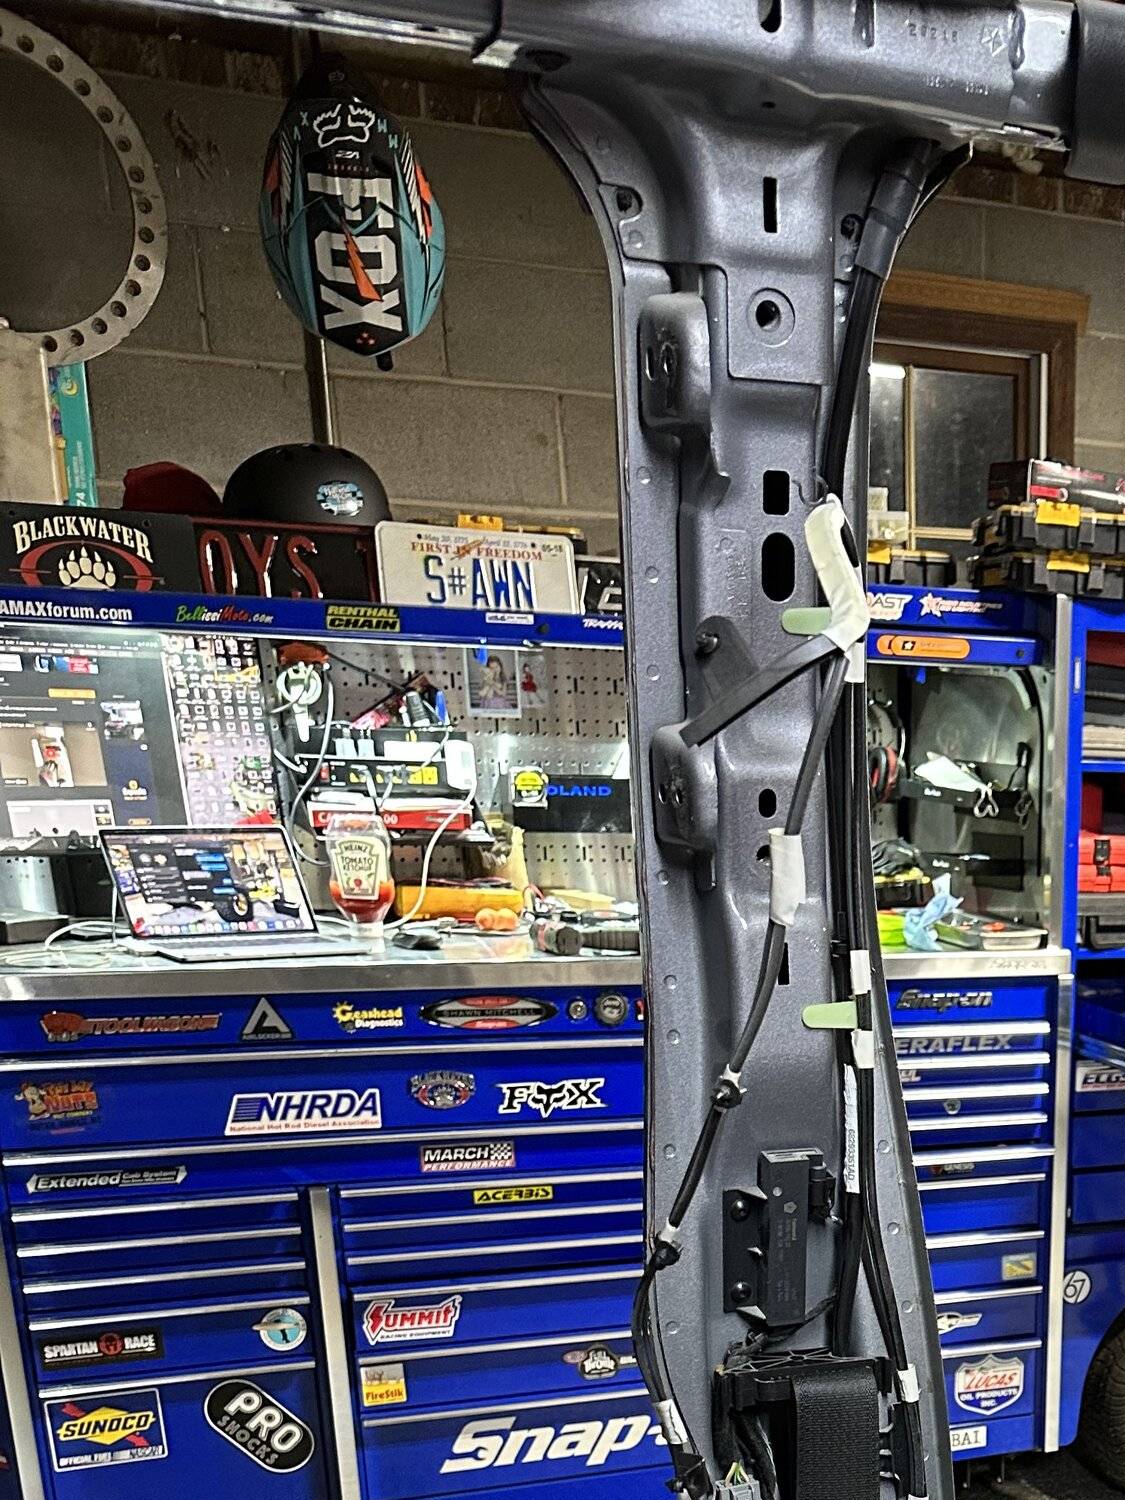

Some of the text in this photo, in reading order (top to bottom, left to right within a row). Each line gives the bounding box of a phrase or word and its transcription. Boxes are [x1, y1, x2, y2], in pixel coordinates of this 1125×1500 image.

[308, 172, 402, 331] FOX
[13, 516, 153, 563] BLACKWATER
[411, 541, 450, 554] FIRST
[477, 547, 542, 560] FREEDOM
[424, 555, 535, 609] S#AWN
[328, 605, 398, 618] RENTHAL
[329, 617, 398, 630] CHAIN
[341, 855, 373, 865] TOMATO
[335, 1003, 402, 1021] Gearhead
[355, 1017, 403, 1029] Diagnostics
[256, 1091, 379, 1121] NHRDA
[332, 1119, 379, 1127] Association
[424, 1147, 489, 1161] MARCH
[423, 1160, 513, 1171] PERFORMANCE
[37, 1171, 121, 1188] Extended
[44, 1334, 156, 1358] SPARTAN RACE
[965, 1372, 1018, 1389] LUCAS
[960, 1388, 1018, 1401] OIL PRODUCTS
[63, 1413, 151, 1436] SUNOCO
[224, 1389, 304, 1453] PRO
[216, 1414, 279, 1465] SHOCKS
[952, 1430, 980, 1447] BAI
